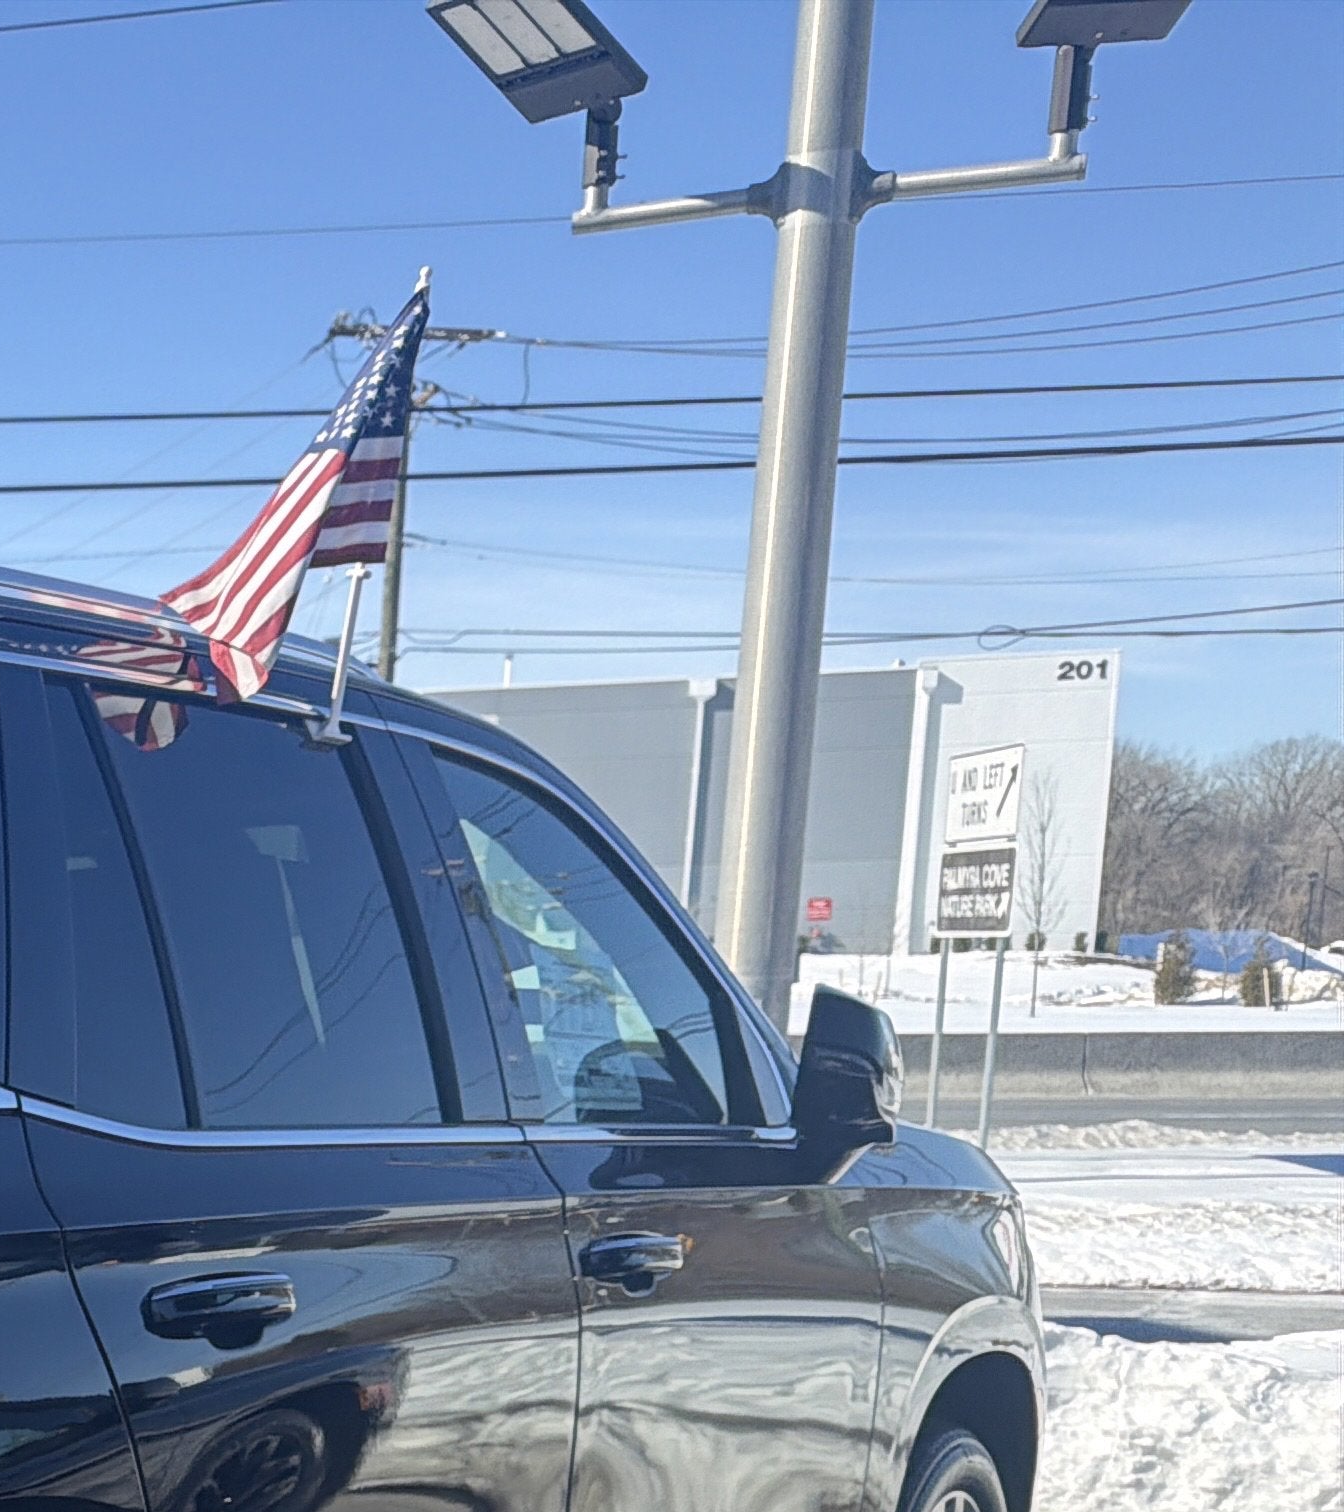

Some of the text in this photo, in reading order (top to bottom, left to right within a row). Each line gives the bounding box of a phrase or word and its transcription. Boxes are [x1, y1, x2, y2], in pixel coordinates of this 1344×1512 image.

[1056, 659, 1109, 681] 201
[983, 760, 1006, 790] LEFT
[982, 862, 1011, 888] COVE
